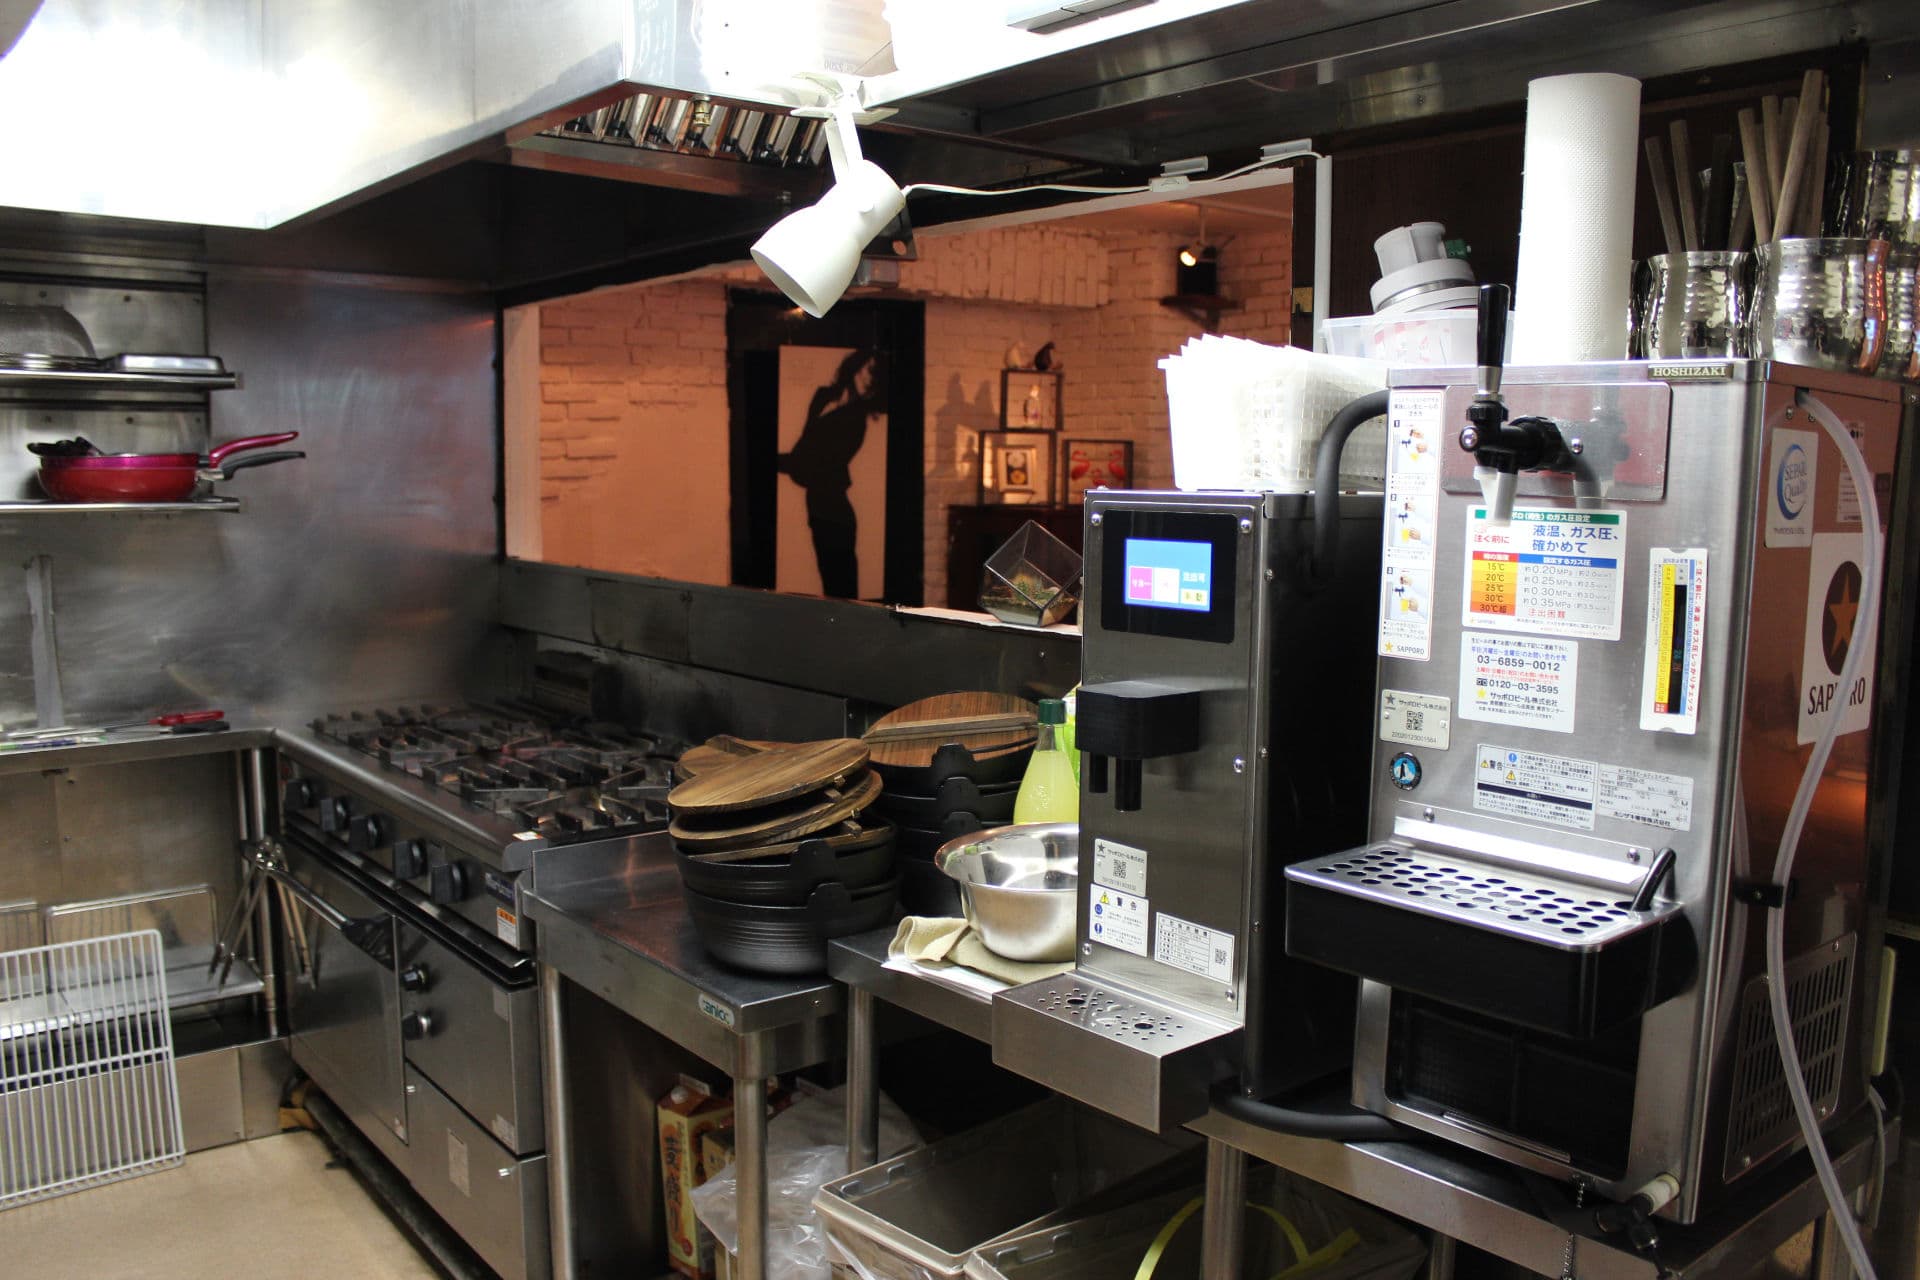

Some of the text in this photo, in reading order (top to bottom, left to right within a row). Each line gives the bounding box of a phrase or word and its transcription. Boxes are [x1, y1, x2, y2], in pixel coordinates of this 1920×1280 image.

[1653, 367, 1726, 377] HOSHIZAKI
[1532, 524, 1619, 541] 液温、ガス圧、
[1532, 539, 1589, 554] 確かめて
[1486, 573, 1505, 582] 20℃
[1485, 584, 1504, 592] 25℃
[1485, 594, 1504, 602] 30℃
[1396, 645, 1425, 655] SAPPORO
[1477, 655, 1560, 671] 03-6859-0012
[1489, 679, 1559, 694] 0120-03-3595
[1490, 692, 1558, 707] サッポロビール株式会社
[1808, 677, 1866, 715] SAPRO
